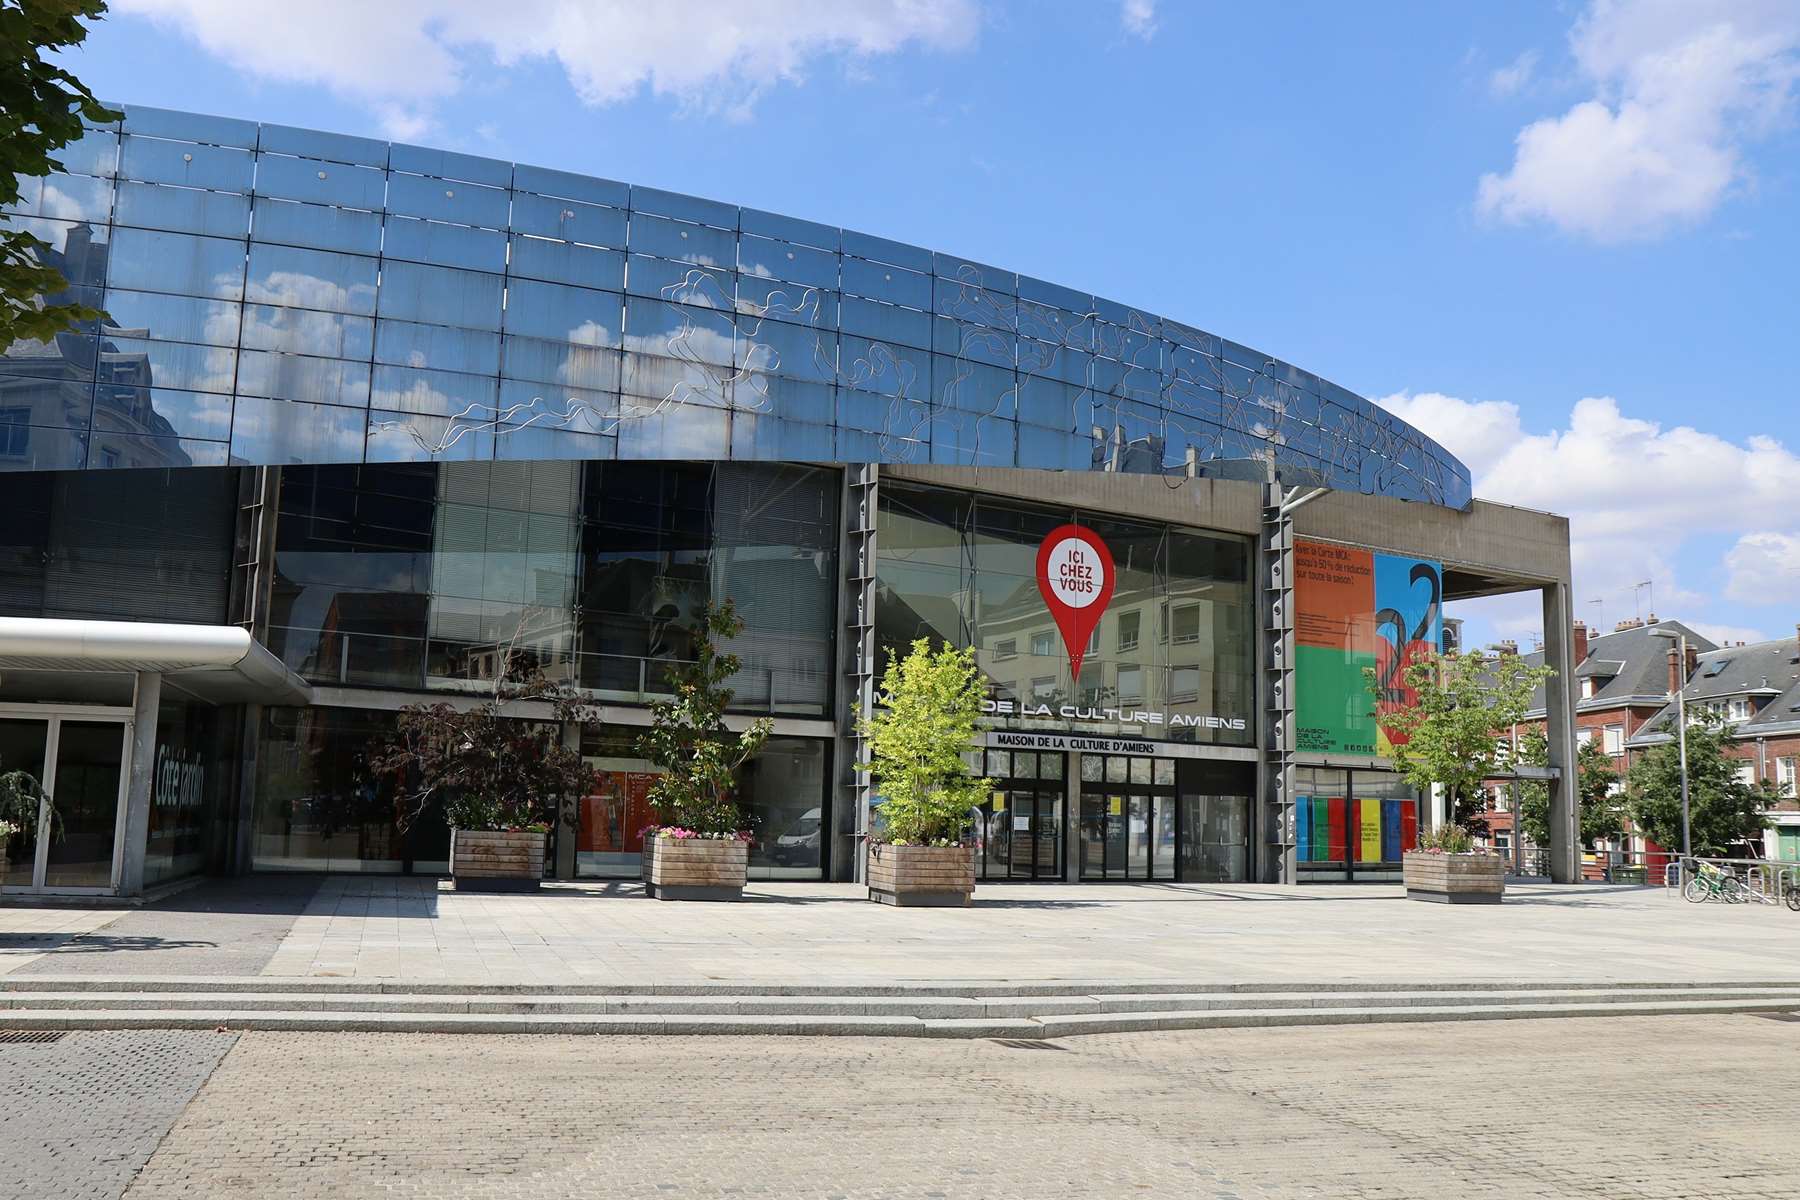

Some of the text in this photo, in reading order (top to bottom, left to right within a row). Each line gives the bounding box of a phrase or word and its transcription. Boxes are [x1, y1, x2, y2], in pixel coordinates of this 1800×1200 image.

[1068, 549, 1084, 564] ICI
[1060, 563, 1093, 580] CHEZ
[1060, 578, 1093, 593] VOUS
[980, 700, 1246, 730] DE LA CULTURE AMIENS
[997, 734, 1155, 754] MAISON DE LA CULTURE D'AMIENS
[156, 744, 180, 806] Côté
